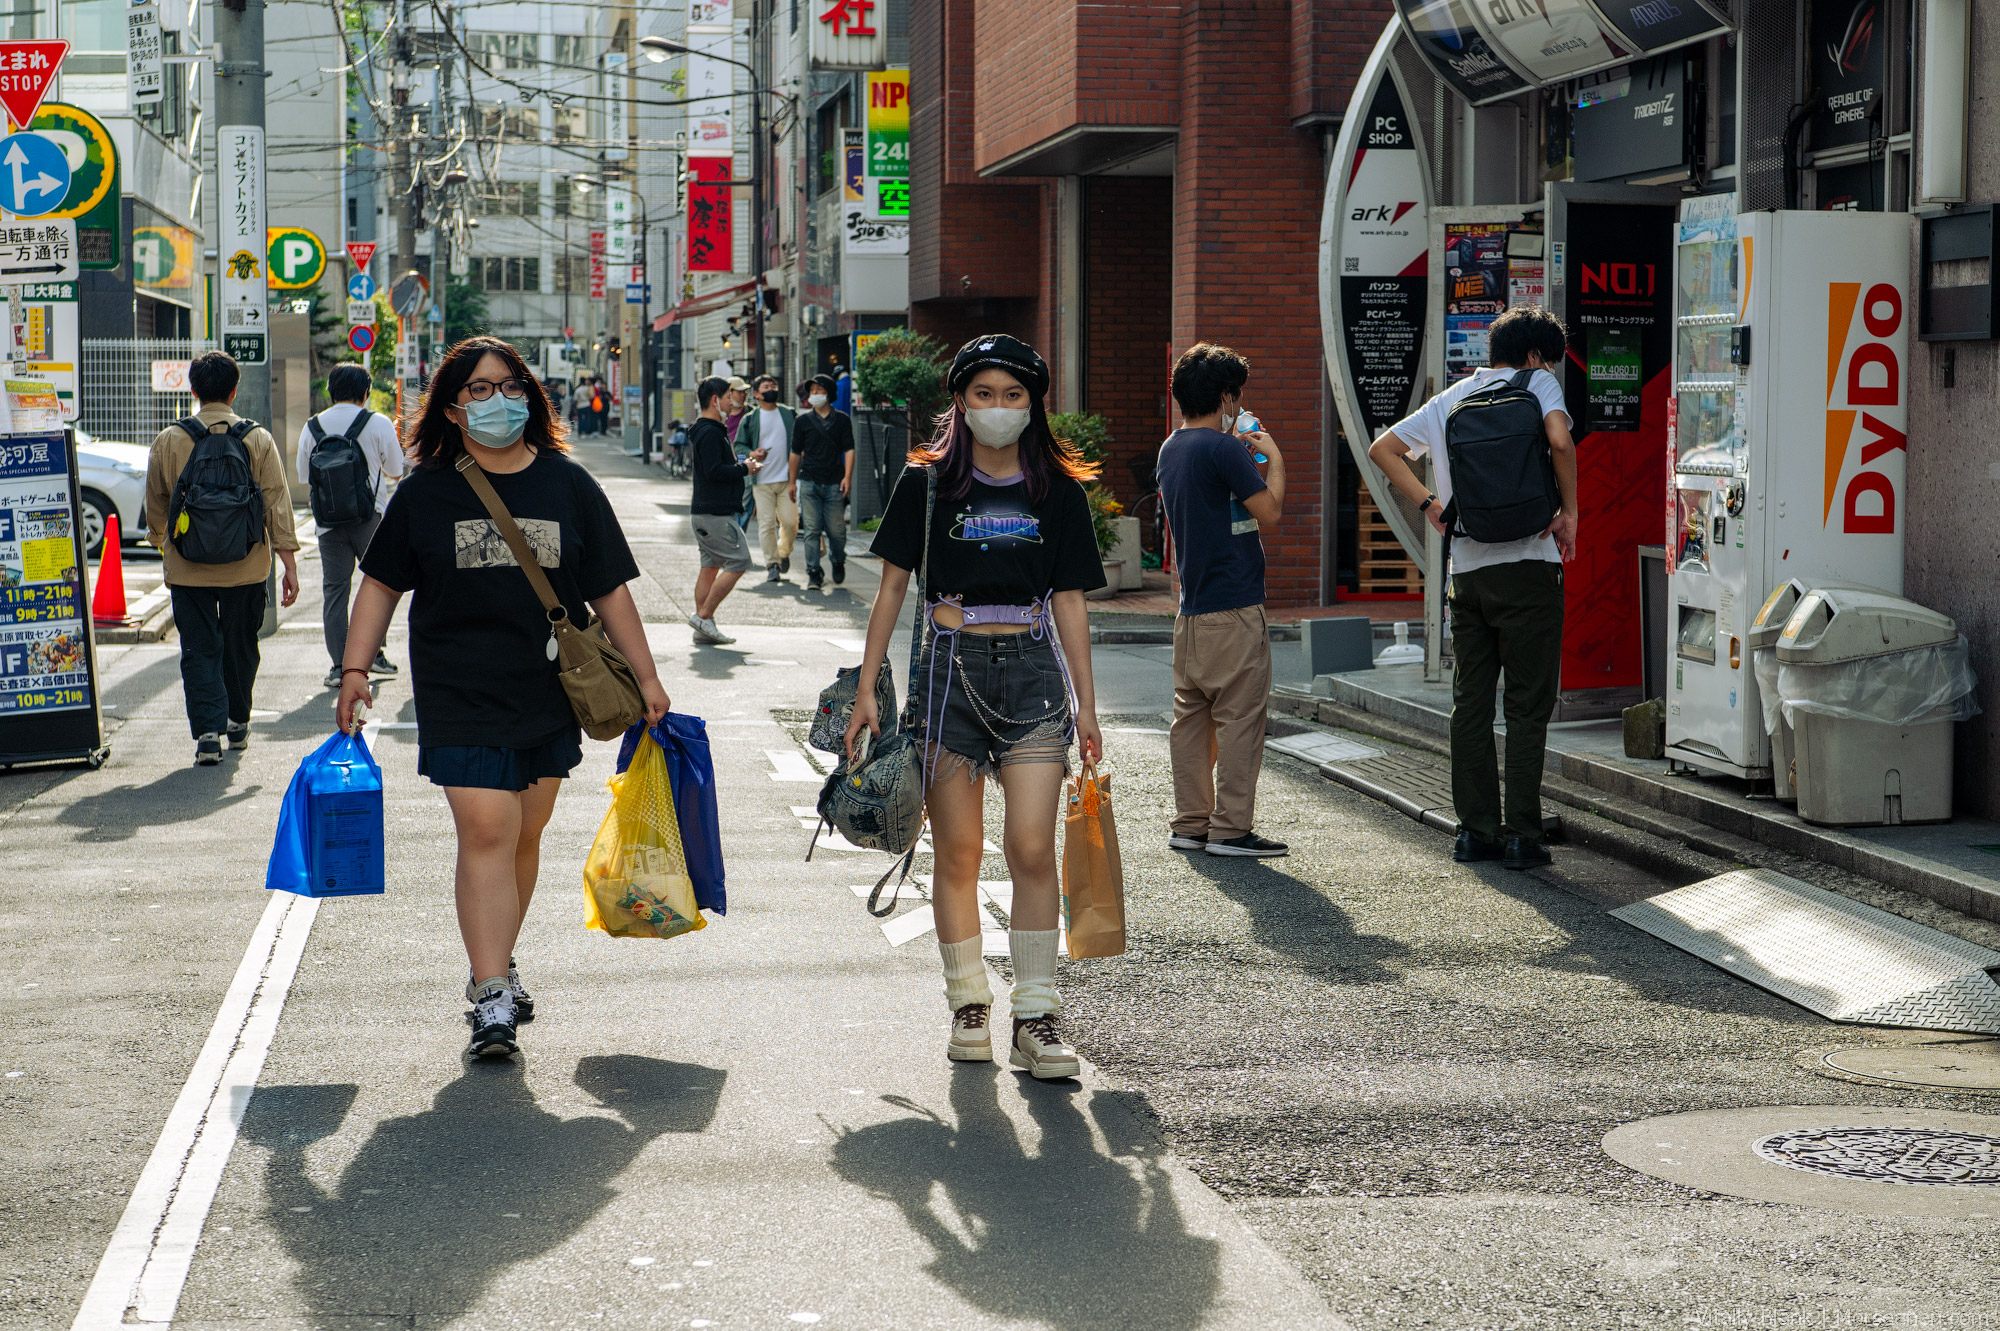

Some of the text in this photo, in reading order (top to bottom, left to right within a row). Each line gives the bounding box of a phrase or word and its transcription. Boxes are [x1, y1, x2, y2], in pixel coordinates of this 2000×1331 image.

[1629, 0, 1683, 29] AORUS
[1448, 53, 1498, 77] SanMax
[1, 75, 42, 91] STOP
[1467, 70, 1510, 86] Technologies
[872, 82, 910, 108] NP
[1828, 88, 1873, 111] REPUBLIC OF
[1835, 107, 1864, 124] GAMERS
[1375, 117, 1397, 131] PC
[1369, 133, 1402, 144] SHOP
[234, 136, 248, 236] コンセプトカフェ
[879, 180, 910, 215] 空
[1351, 205, 1392, 221] ark
[0, 226, 69, 244] 自転車を除く
[0, 244, 69, 262] 一方通行
[284, 240, 314, 278] P
[632, 266, 645, 282] P
[1581, 262, 1655, 297] NO.1
[24, 284, 73, 298] 最大料金
[1369, 283, 1400, 291] パソコン
[1455, 282, 1470, 298] M4
[1367, 310, 1401, 318] PCパーツ
[230, 339, 259, 349] 外神田
[235, 350, 255, 360] 3-9
[1590, 365, 1638, 374] RTX 4060 Ti
[1358, 376, 1409, 384] ゲームデバイス
[1618, 395, 1639, 403] 22:00
[1604, 405, 1624, 416] 解禁
[1844, 282, 1907, 534] DyDo
[1, 492, 67, 507] ボードゲーム館
[963, 517, 1040, 538] ALLBUBBLE
